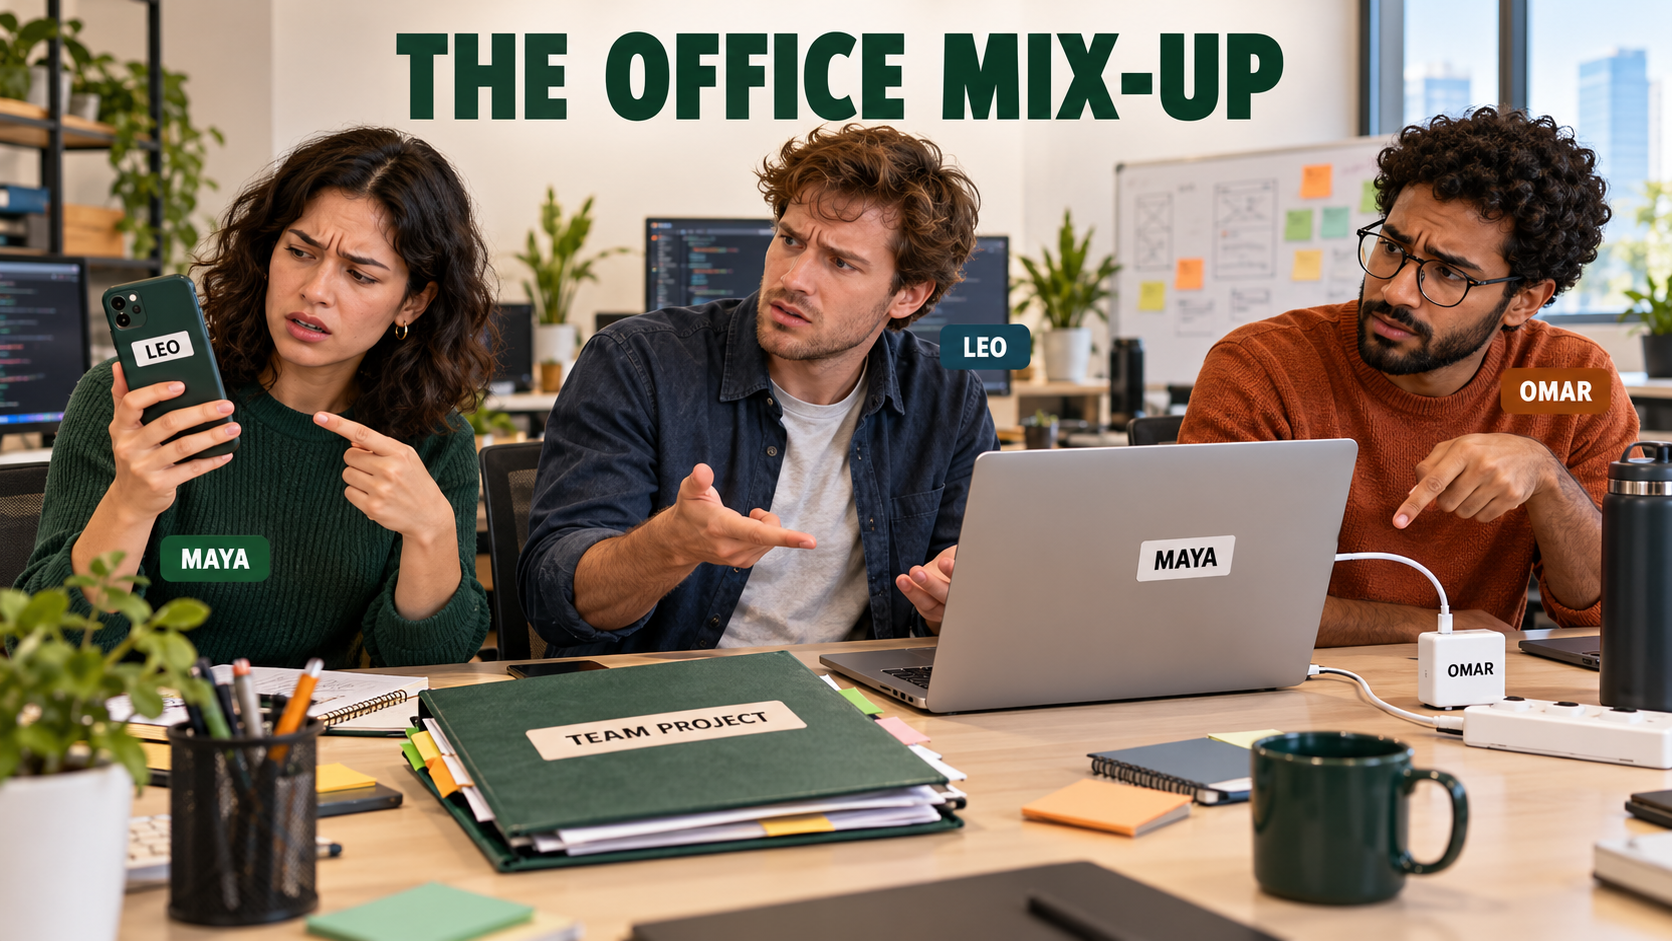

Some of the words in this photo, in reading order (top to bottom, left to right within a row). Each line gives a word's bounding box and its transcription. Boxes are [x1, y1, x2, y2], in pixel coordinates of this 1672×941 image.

[145, 339, 181, 360] LEO
[1154, 547, 1218, 571] MAYA
[1447, 661, 1494, 678] OMAR
[565, 726, 649, 746] TEAM
[656, 711, 768, 735] PROJECT
